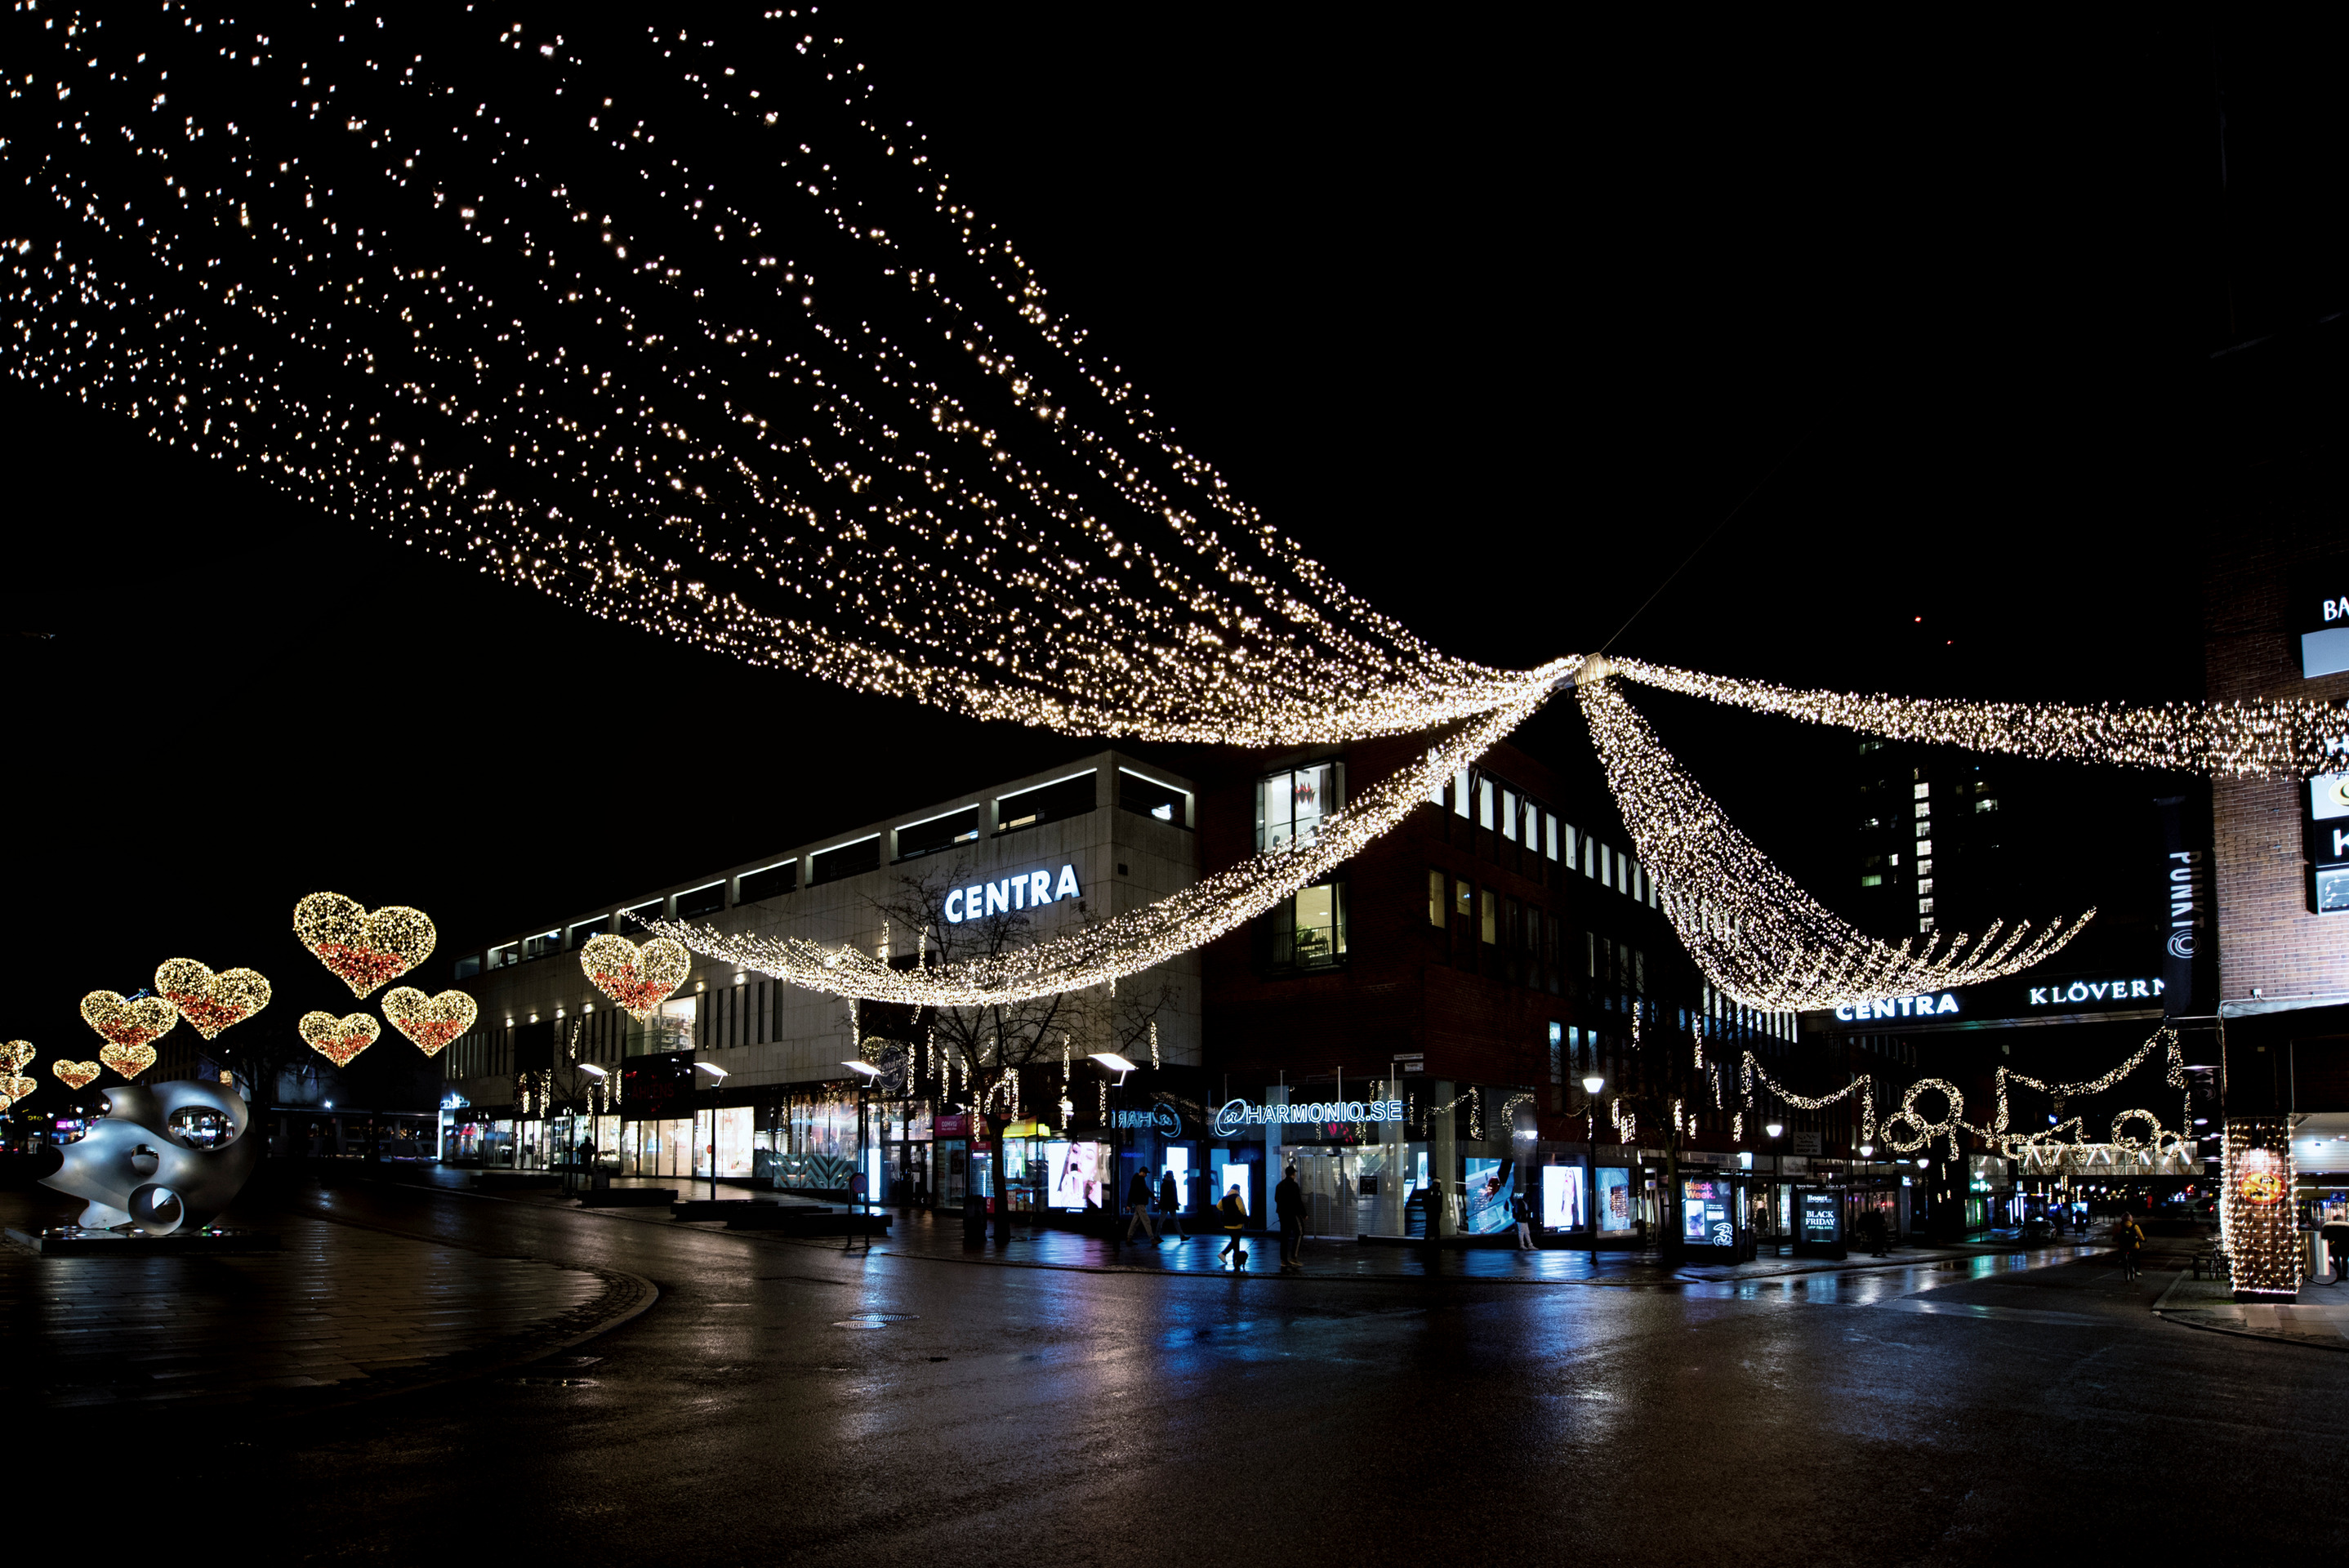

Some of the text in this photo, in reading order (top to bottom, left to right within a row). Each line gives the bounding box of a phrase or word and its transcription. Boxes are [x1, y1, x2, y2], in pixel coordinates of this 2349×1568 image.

[944, 864, 1081, 923] CENTRA
[2169, 850, 2205, 928] PUNKT
[1835, 993, 1959, 1021] CENTRA
[1684, 1182, 1712, 1190] Black
[1685, 1191, 1716, 1199] Week.
[1805, 1218, 1835, 1226] FRIDAY
